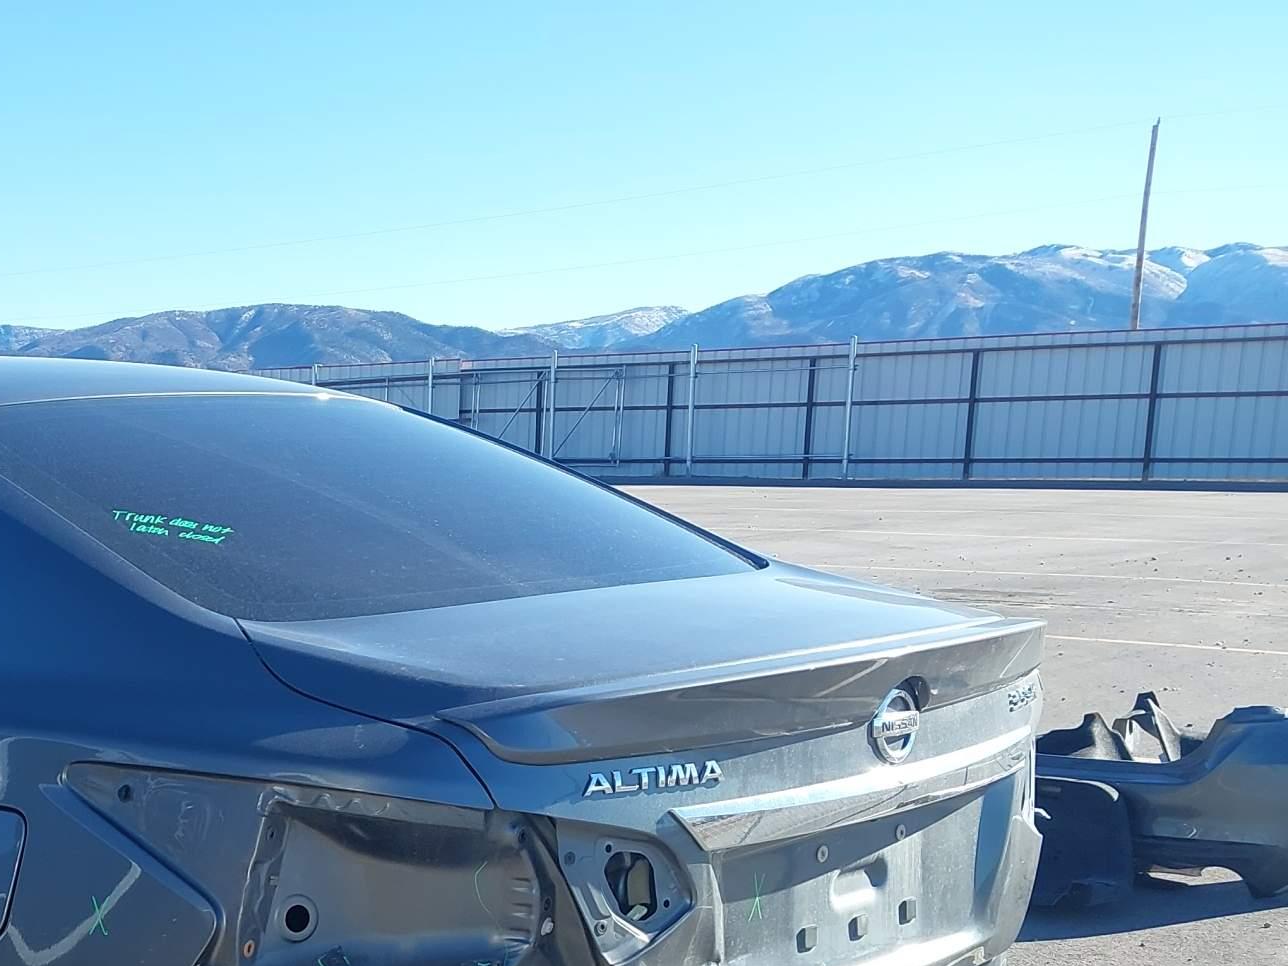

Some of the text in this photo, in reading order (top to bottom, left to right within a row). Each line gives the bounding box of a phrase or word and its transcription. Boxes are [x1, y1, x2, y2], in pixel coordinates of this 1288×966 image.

[201, 523, 235, 534] not
[881, 713, 918, 733] NISSAN
[583, 759, 726, 798] ALTIMA
